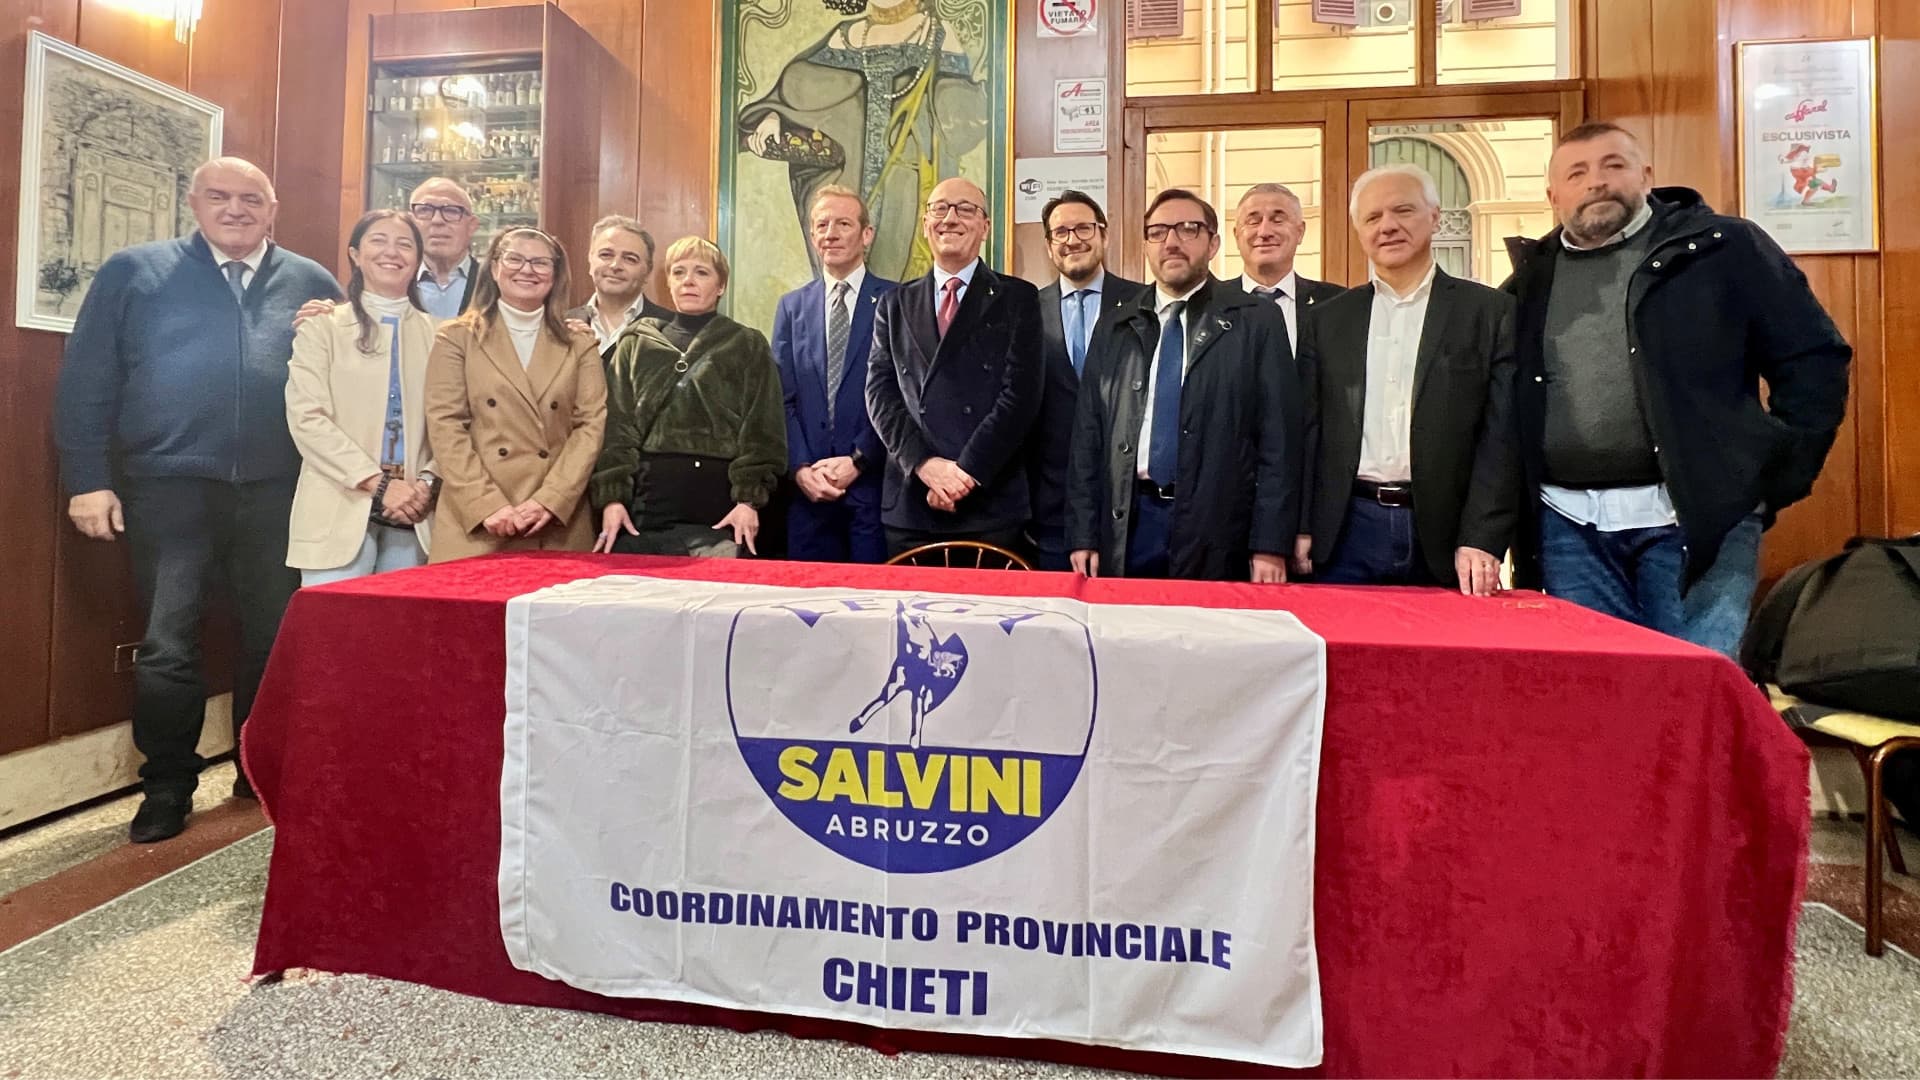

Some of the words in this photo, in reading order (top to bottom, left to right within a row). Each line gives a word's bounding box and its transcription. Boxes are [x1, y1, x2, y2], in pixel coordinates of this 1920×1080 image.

[1762, 130, 1851, 142] ESCLUSIVISTA
[777, 746, 1042, 818] SALVINI
[825, 814, 989, 847] ABRUZZO
[610, 881, 938, 941] COORDINAMENTO
[957, 910, 1232, 970] PROVINCIALE
[823, 957, 988, 1016] CHIETI
